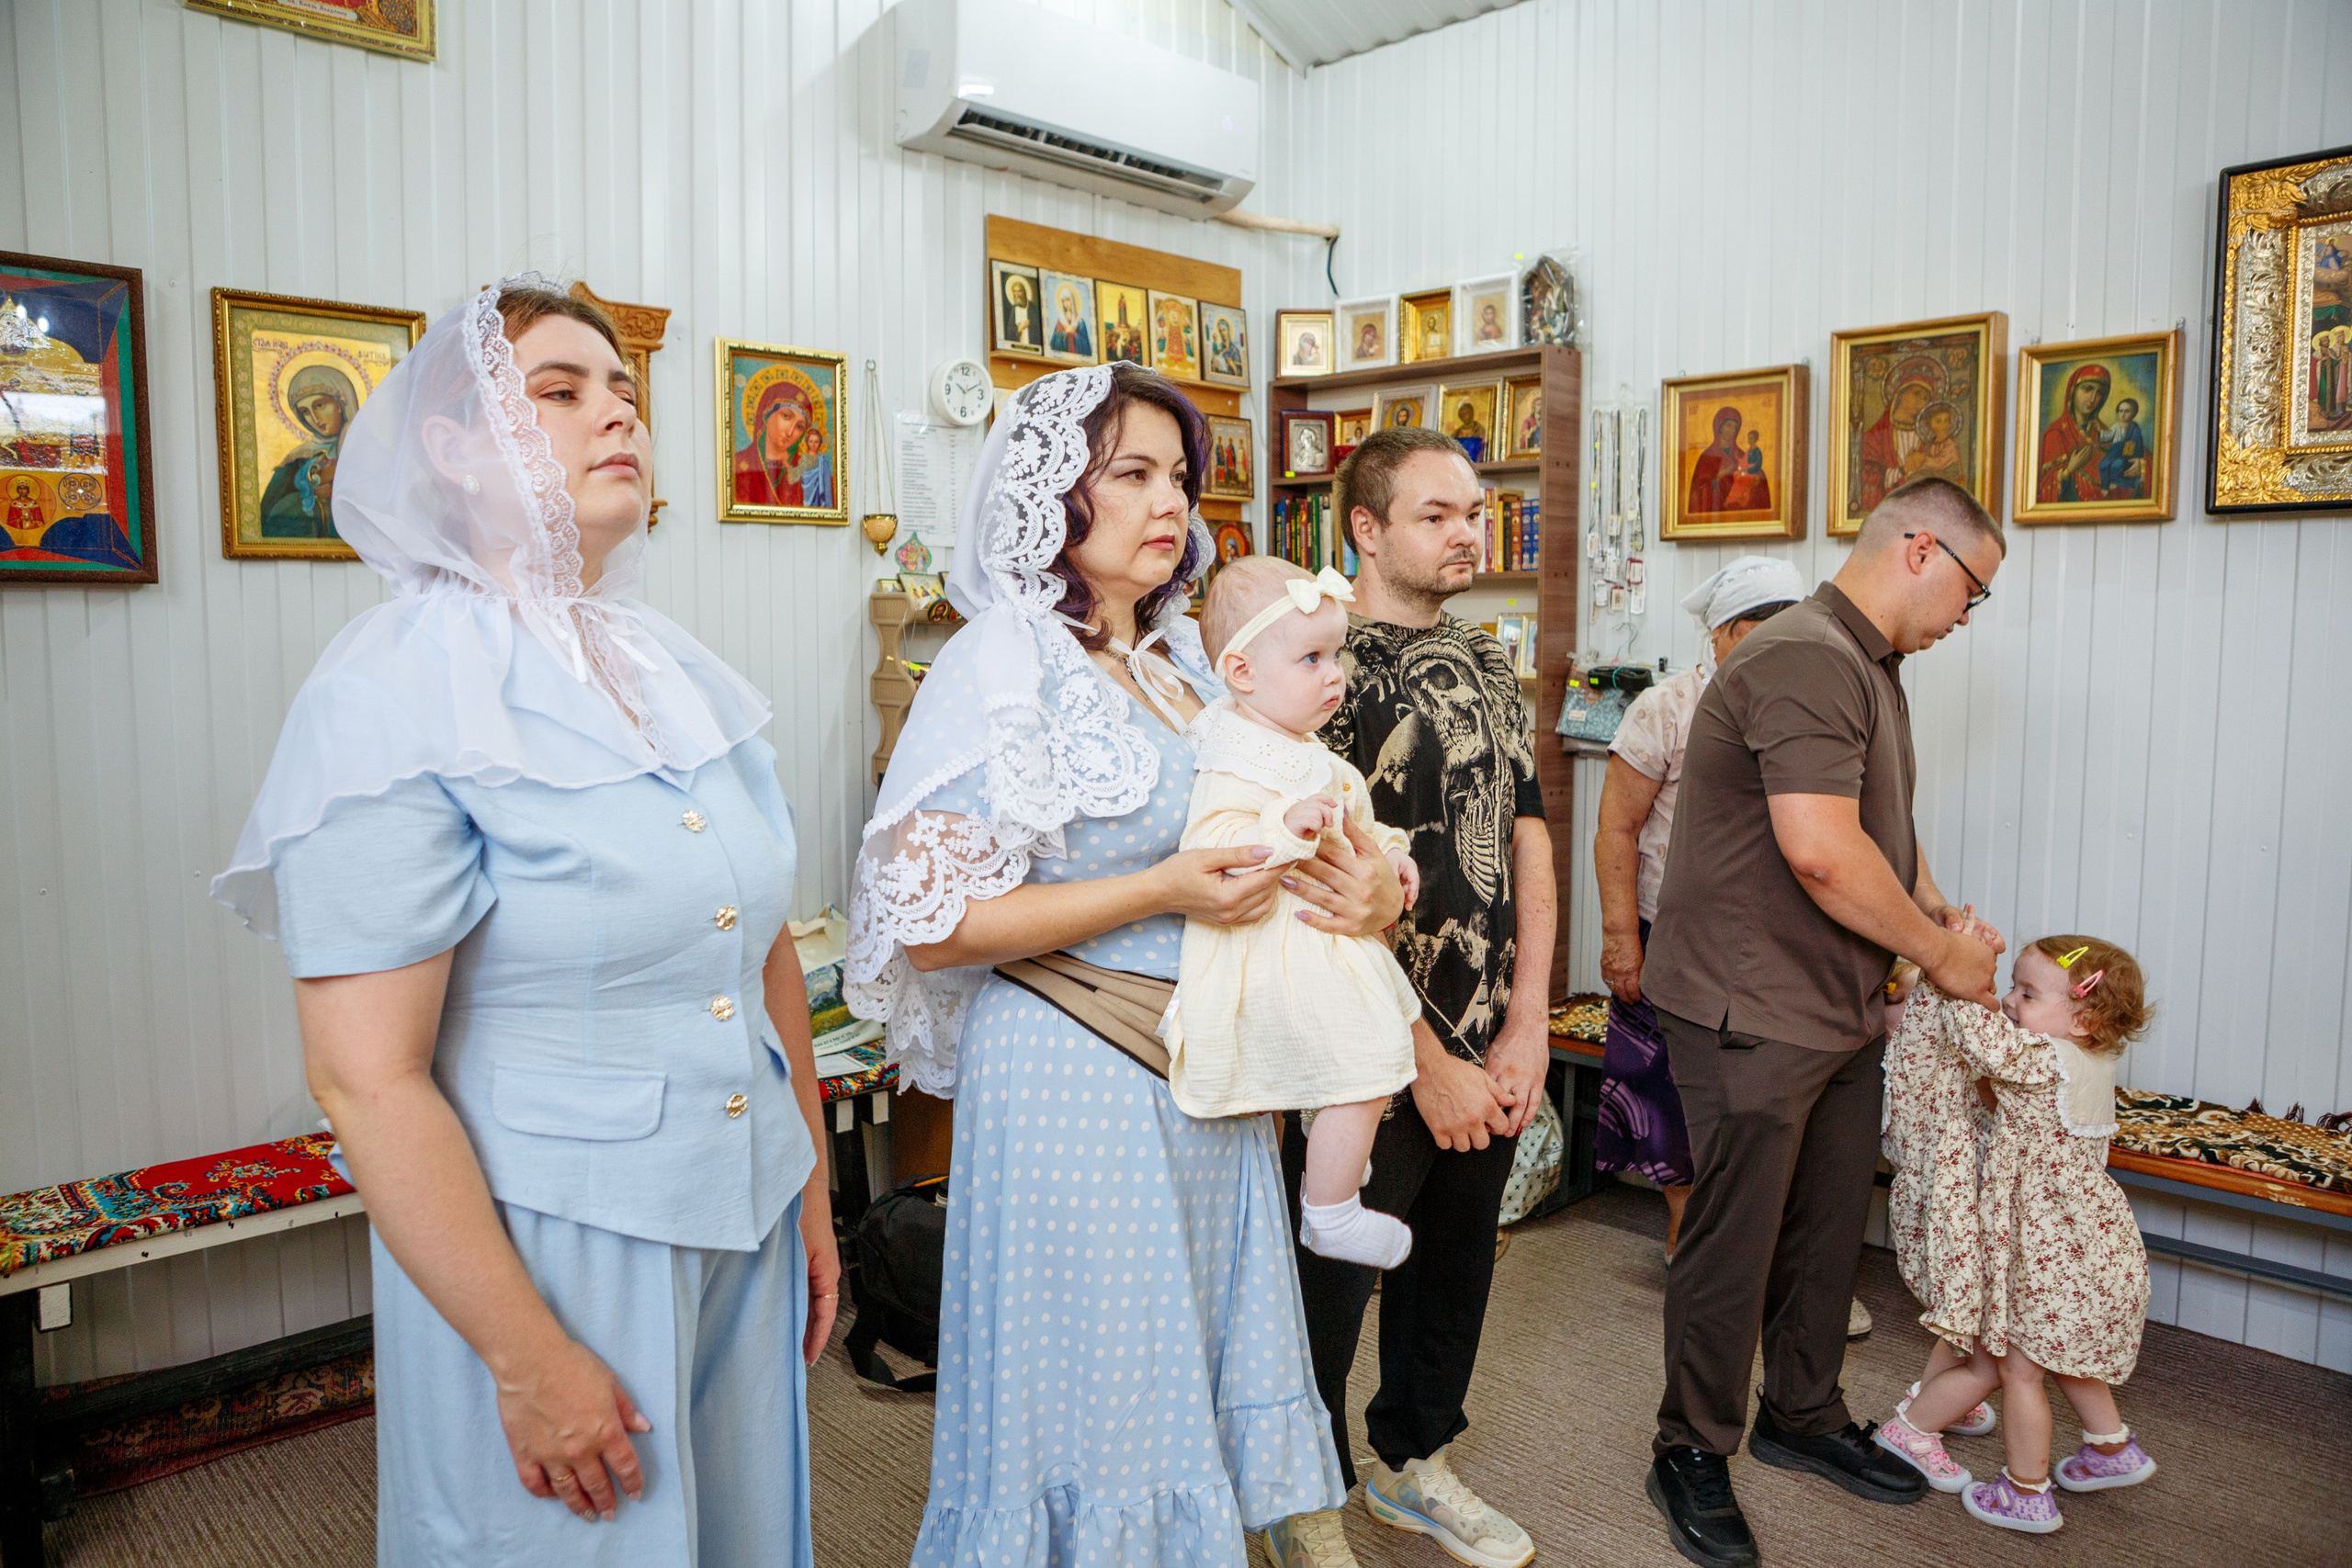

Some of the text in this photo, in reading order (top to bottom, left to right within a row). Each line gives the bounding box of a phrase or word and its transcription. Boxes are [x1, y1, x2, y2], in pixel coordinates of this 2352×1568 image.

[960, 367, 970, 377] 12
[944, 383, 951, 396] 9
[978, 389, 984, 400] 3
[960, 406, 967, 418] 6
